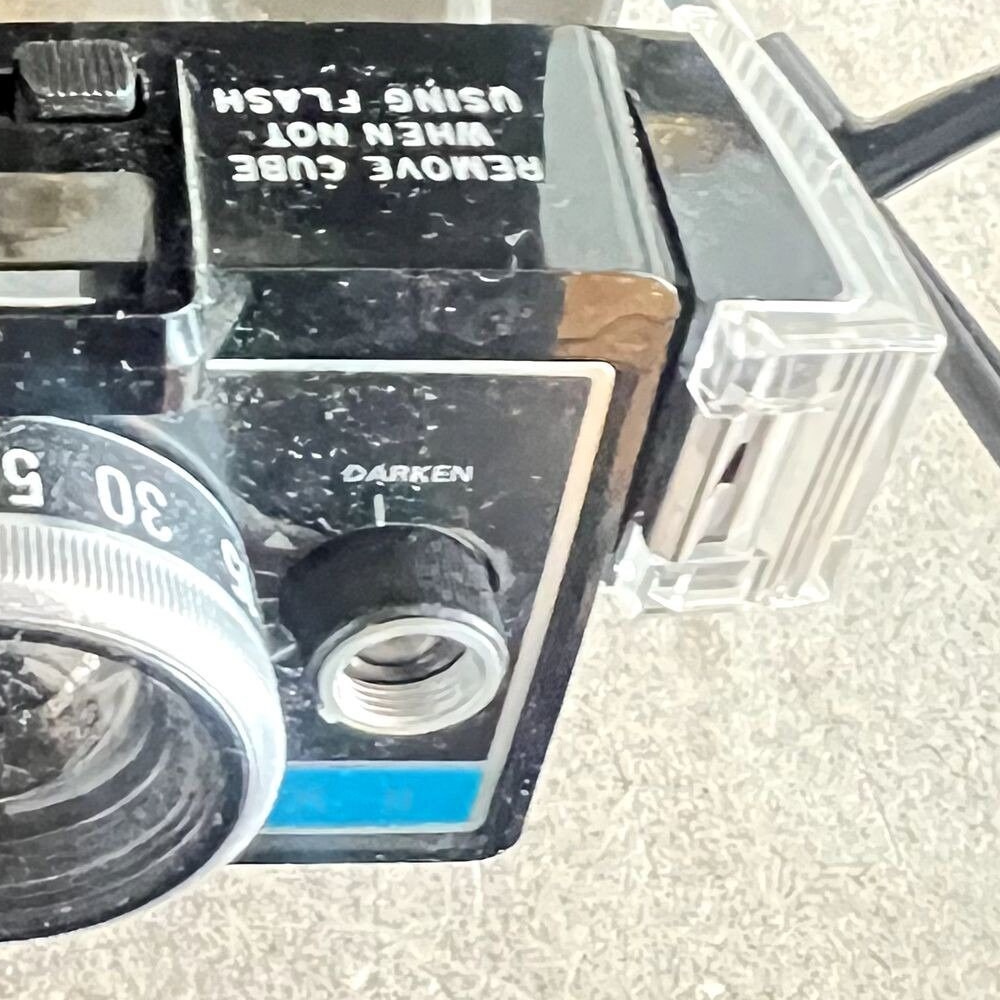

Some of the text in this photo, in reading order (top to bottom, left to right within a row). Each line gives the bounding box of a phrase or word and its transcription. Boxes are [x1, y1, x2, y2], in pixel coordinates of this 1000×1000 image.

[213, 86, 523, 114] USING FLASH
[264, 122, 495, 148] WHEN NOT
[228, 154, 545, 182] REMOVE CUBE
[340, 463, 474, 482] DARKEN
[95, 465, 173, 542] 30
